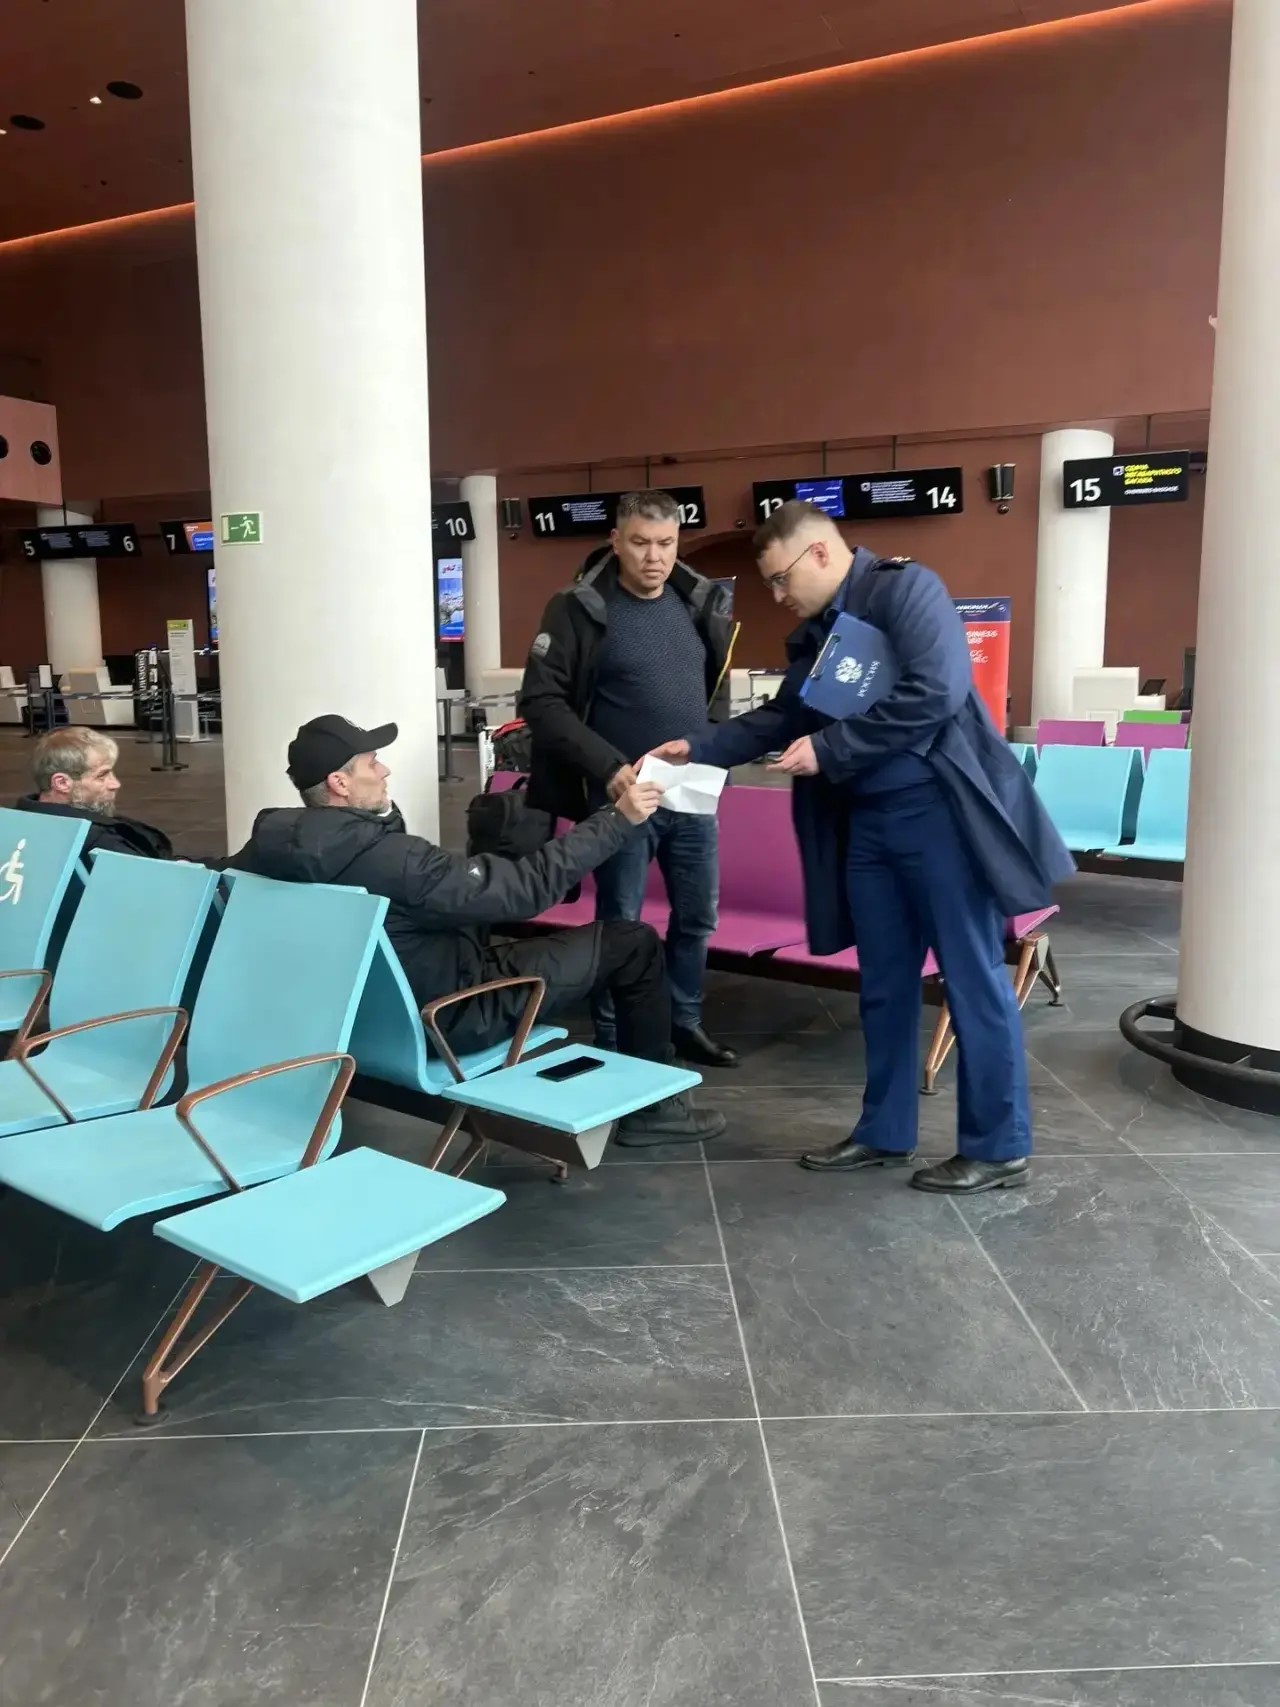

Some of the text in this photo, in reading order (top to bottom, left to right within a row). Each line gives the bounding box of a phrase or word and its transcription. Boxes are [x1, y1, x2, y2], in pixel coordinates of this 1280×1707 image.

[926, 486, 957, 510] 14
[1069, 477, 1102, 503] 15
[535, 511, 556, 532] 11
[676, 503, 700, 525] 12
[445, 517, 468, 537] 10
[23, 540, 36, 556] 5
[122, 535, 135, 552] 6
[166, 534, 176, 550] 7
